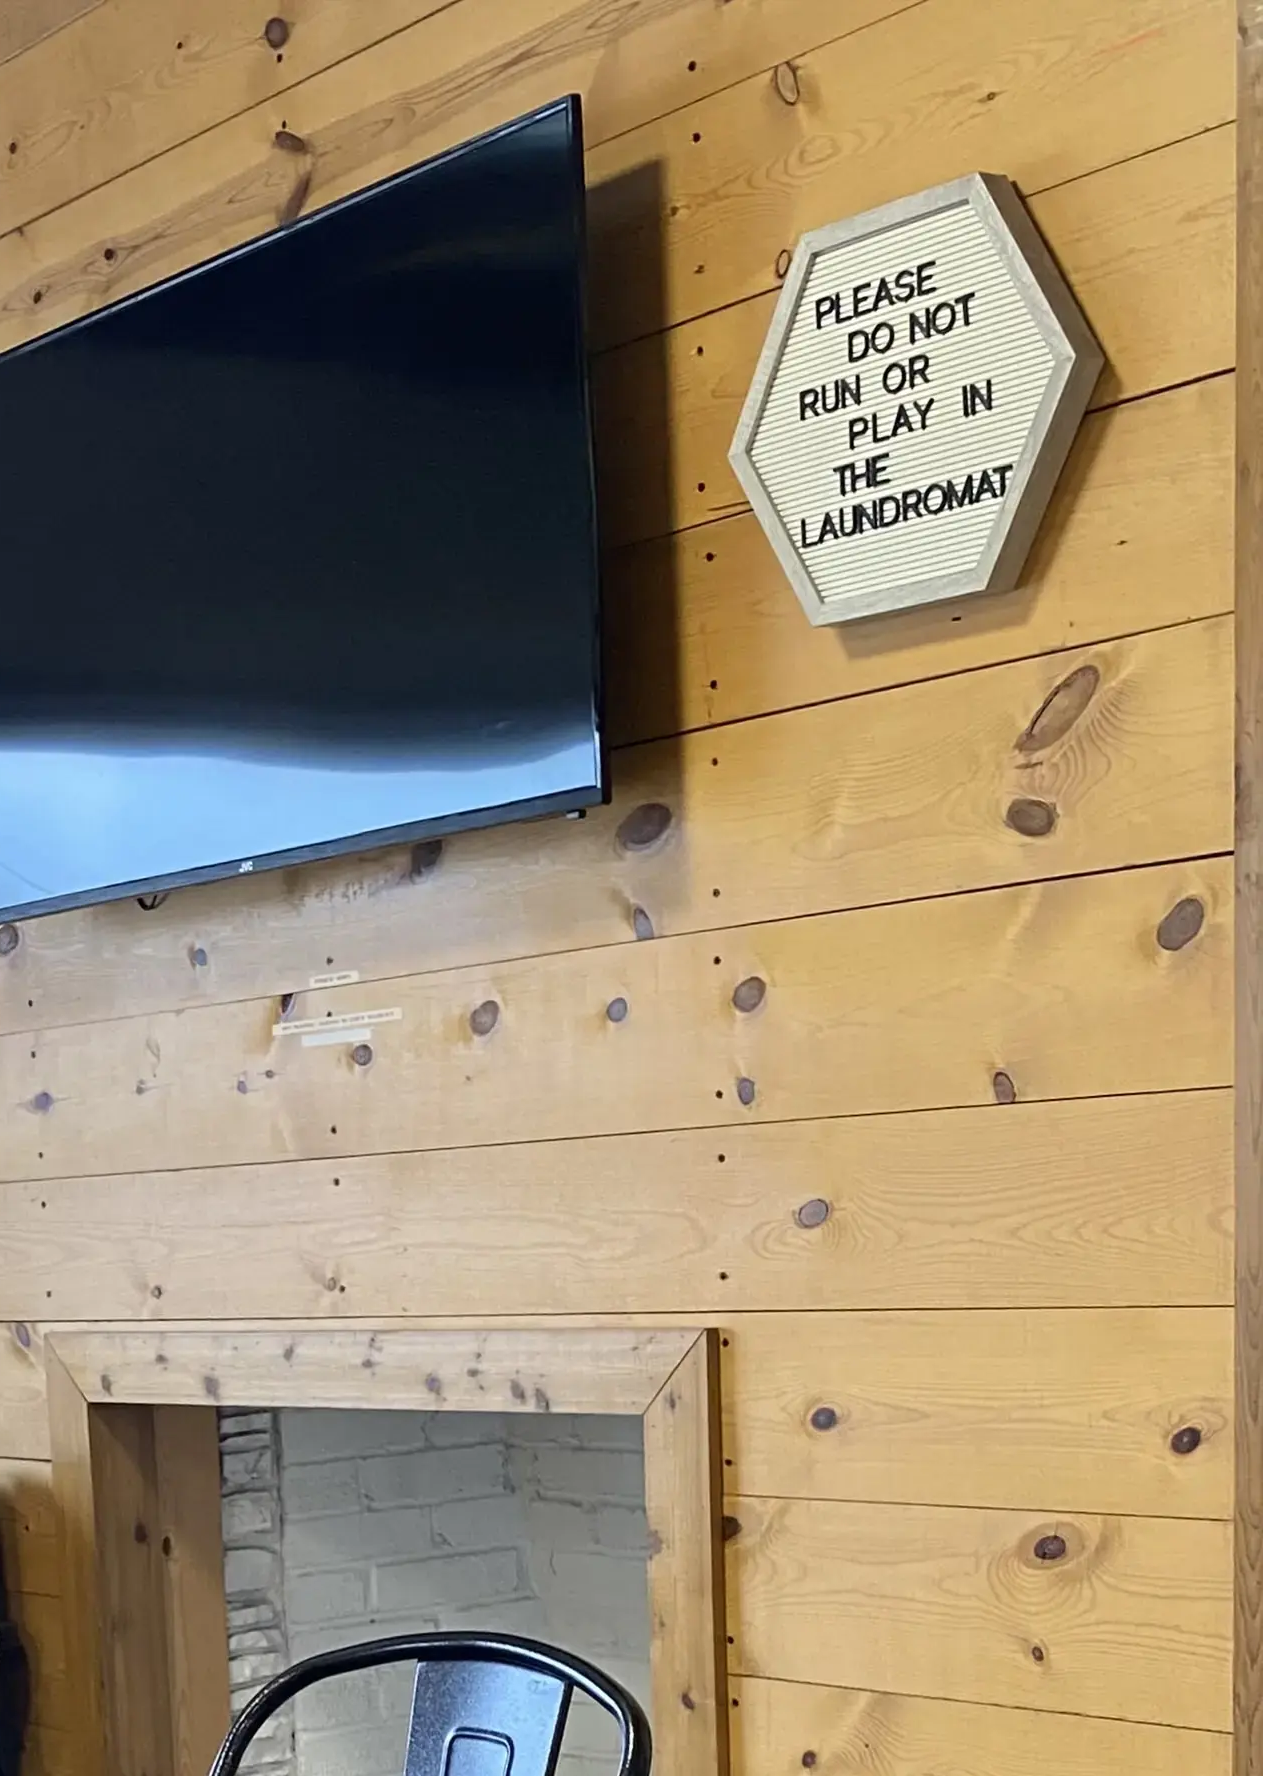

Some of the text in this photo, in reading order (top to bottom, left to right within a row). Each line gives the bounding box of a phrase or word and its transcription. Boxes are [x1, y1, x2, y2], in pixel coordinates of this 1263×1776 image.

[814, 261, 937, 329] PLEASE
[847, 292, 976, 363] DO NOT
[799, 354, 931, 421] RUN OR
[848, 379, 994, 450] PLAY IN
[800, 463, 1014, 550] LAUNDROMAT
[833, 453, 891, 497] THE
